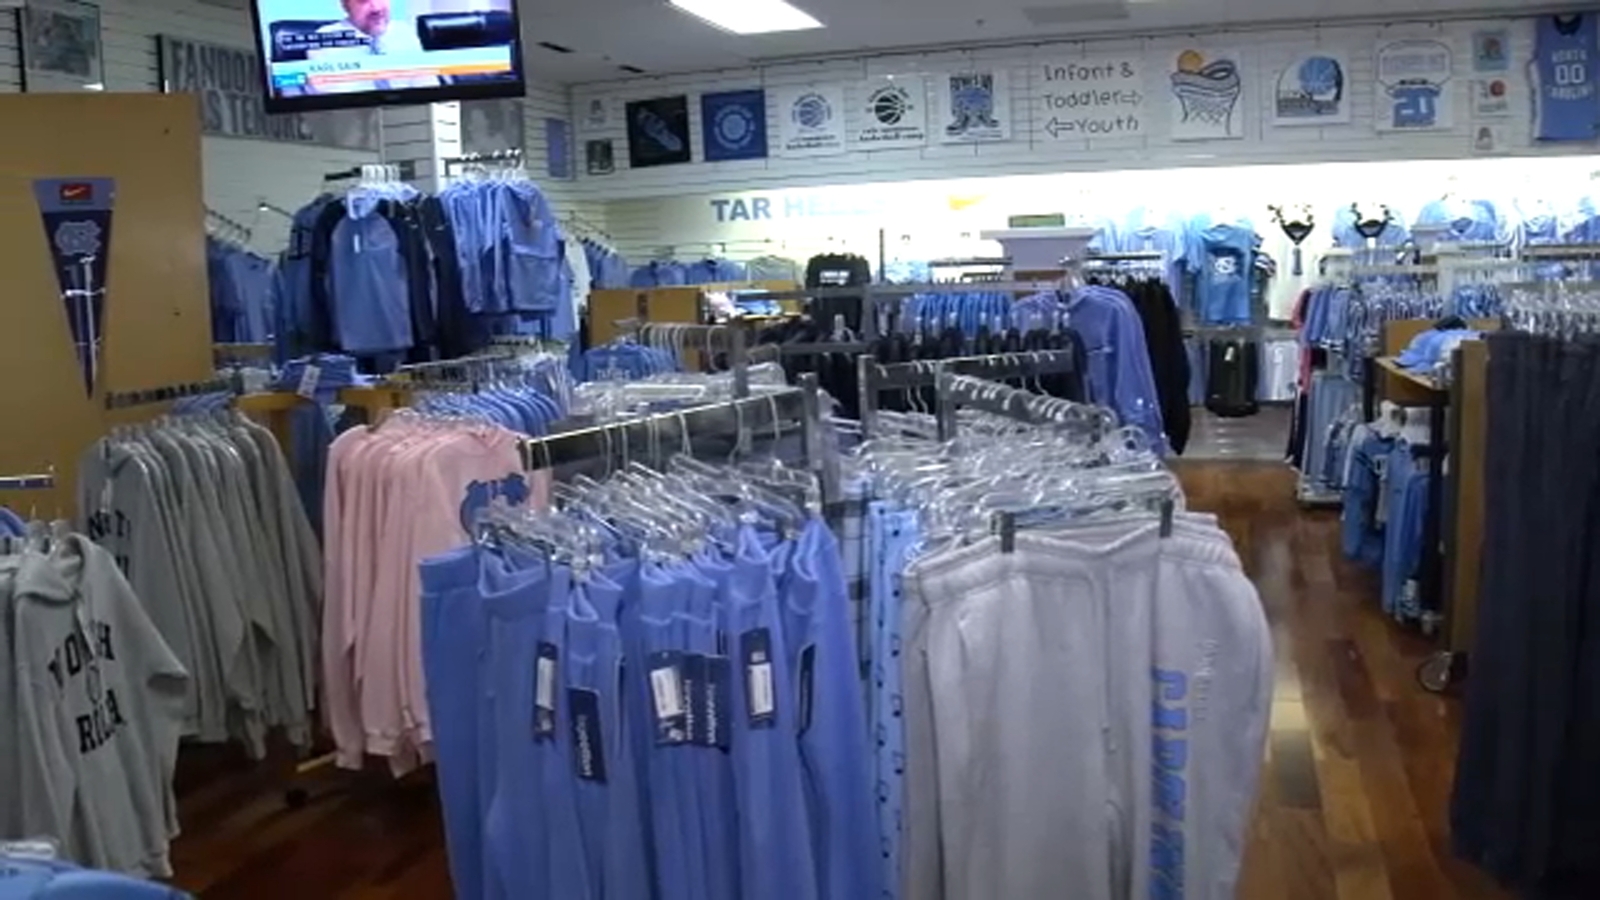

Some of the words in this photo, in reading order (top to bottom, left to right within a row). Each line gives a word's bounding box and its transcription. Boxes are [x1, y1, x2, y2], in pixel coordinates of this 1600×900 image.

[1043, 62, 1114, 81] Infant
[1120, 61, 1135, 79] &
[1042, 89, 1121, 110] Toddler
[1074, 115, 1139, 133] Youth
[710, 197, 772, 222] TAR
